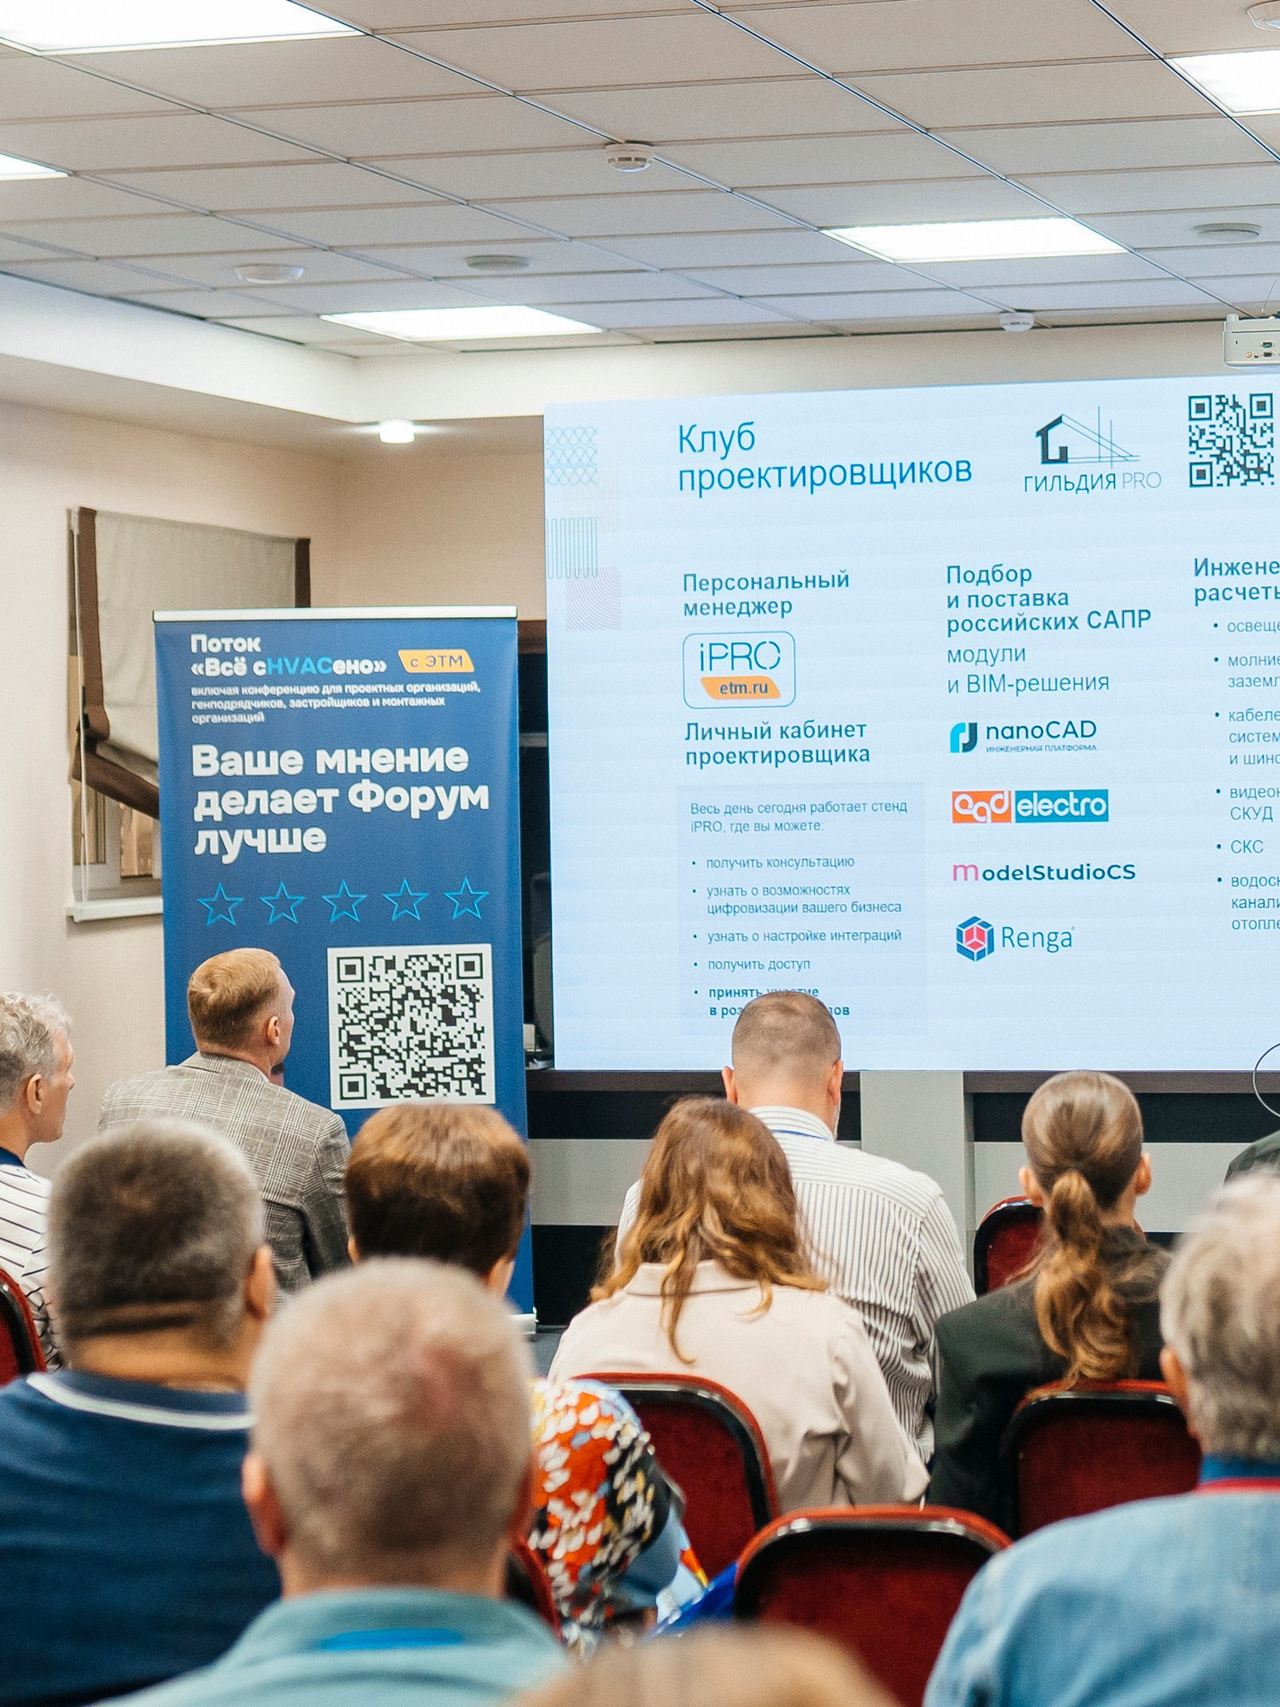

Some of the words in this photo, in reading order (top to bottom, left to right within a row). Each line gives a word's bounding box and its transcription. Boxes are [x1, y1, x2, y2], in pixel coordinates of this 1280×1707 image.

[680, 421, 755, 460] Клуб
[680, 460, 972, 498] проектировщиков
[1025, 473, 1116, 494] ГИЛЬДИЯ
[1123, 472, 1162, 489] PRO
[684, 569, 849, 596] Персональный
[947, 564, 1032, 587] Подбор
[684, 601, 792, 618] менеджер
[947, 595, 959, 608] и
[968, 593, 1068, 608] поставка
[948, 612, 1079, 638] российских
[1087, 609, 1151, 629] САПР
[191, 634, 260, 653] Поток
[410, 658, 418, 667] с
[425, 654, 463, 668] ЭТМ
[700, 641, 780, 671] iPRO
[948, 648, 1025, 667] модули
[191, 658, 247, 677] «Всё
[253, 657, 386, 675] сHVACено»
[191, 686, 238, 696] включая
[242, 685, 319, 696] конференцию
[322, 685, 342, 695] для
[345, 684, 403, 695] проектных
[406, 681, 480, 694] организаций,
[720, 682, 768, 694] etm.ru
[948, 680, 958, 693] и
[968, 674, 1109, 697] BIM-решения
[191, 700, 286, 710] генподрядчиков,
[289, 697, 370, 709] застройщиков
[382, 698, 444, 708] монтажных
[192, 712, 264, 724] организаций
[685, 721, 771, 740] Личный
[780, 719, 867, 739] кабинет
[987, 720, 1096, 739] nanoCAD
[191, 744, 303, 777] Ваше
[316, 744, 469, 774] мнение
[686, 749, 870, 769] проектировщика
[1230, 755, 1238, 765] и
[193, 786, 338, 823] делает
[348, 779, 489, 819] Форум
[691, 803, 720, 814] Весь
[724, 805, 753, 816] день
[758, 804, 806, 815] сегодня
[810, 801, 867, 815] работает
[872, 802, 907, 813] стенд
[1018, 793, 1106, 817] electro
[1230, 806, 1273, 823] СКУД
[691, 821, 725, 833] iPRO,
[730, 823, 749, 834] где
[754, 823, 770, 831] вы
[775, 820, 824, 832] можете:
[193, 823, 326, 863] лучше
[1231, 840, 1263, 853] СКС
[707, 859, 763, 871] получить
[767, 858, 854, 870] консультацию
[707, 887, 747, 899] узнать
[751, 887, 758, 896] о
[763, 886, 850, 896] возможностях
[708, 903, 798, 916] цифровизации
[803, 904, 847, 913] вашего
[851, 901, 901, 912] бизнеса
[708, 933, 748, 944] узнать
[752, 933, 759, 942] о
[764, 930, 826, 944] настройке
[831, 929, 901, 943] интеграций
[1002, 927, 1072, 953] Renga
[709, 961, 764, 972] получить
[768, 960, 810, 972] доступ
[710, 1007, 717, 1015] в
